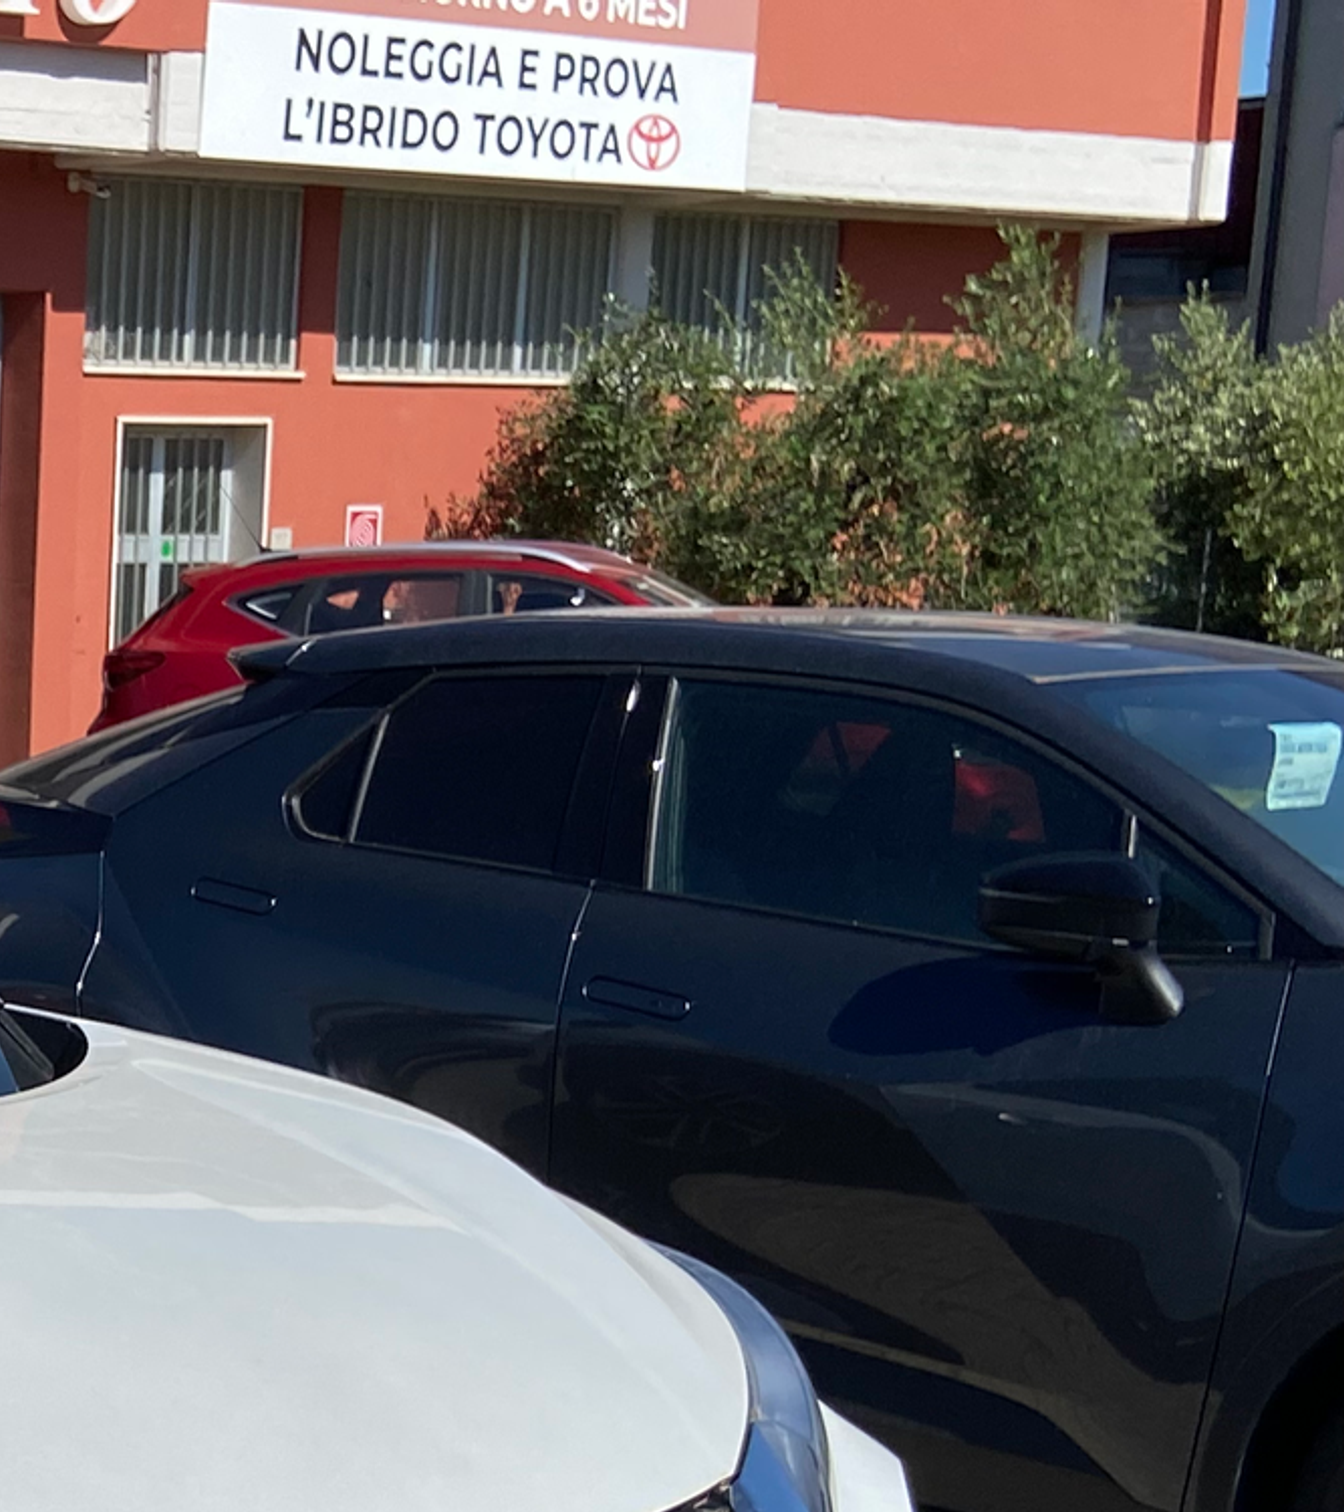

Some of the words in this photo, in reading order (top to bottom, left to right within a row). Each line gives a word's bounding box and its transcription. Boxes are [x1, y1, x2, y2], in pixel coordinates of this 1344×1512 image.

[295, 27, 503, 88] NOLEGGIA
[518, 48, 540, 91] E
[552, 51, 679, 104] PROVA
[283, 96, 460, 153] L'IBRIDO
[473, 113, 622, 165] TOYOTA
